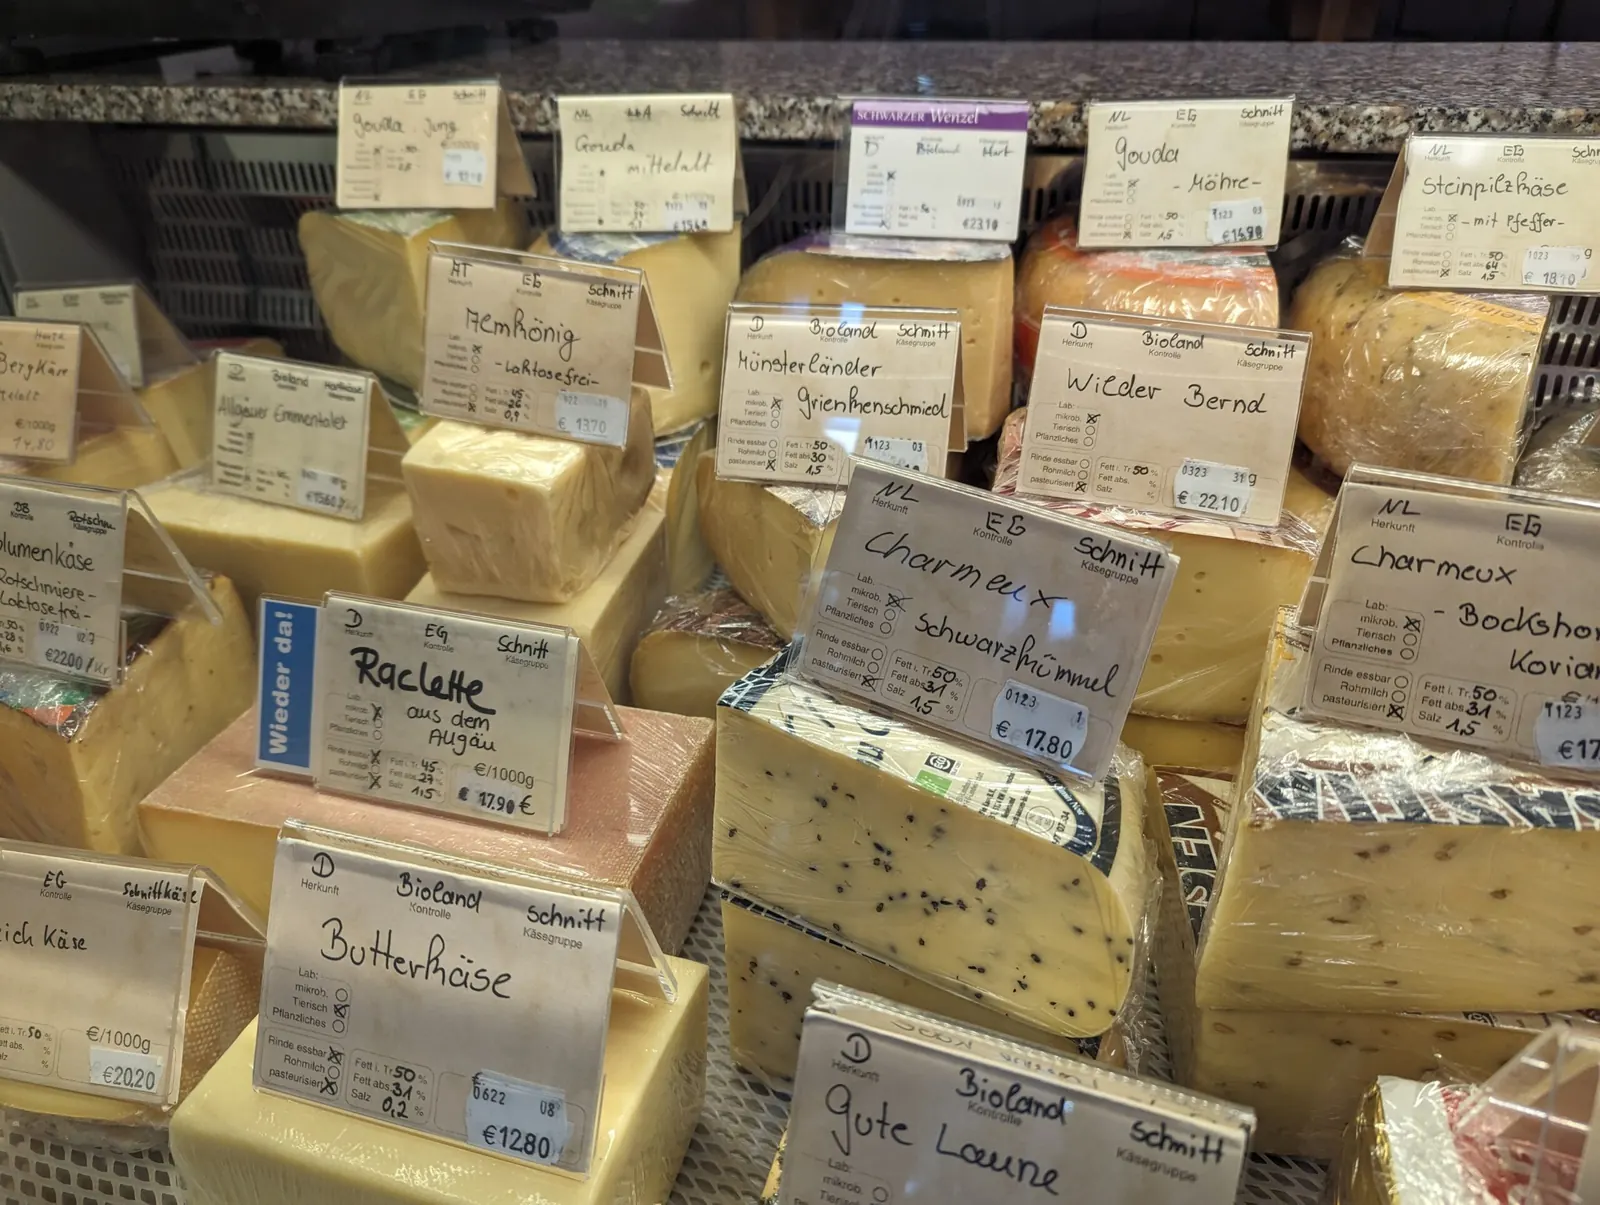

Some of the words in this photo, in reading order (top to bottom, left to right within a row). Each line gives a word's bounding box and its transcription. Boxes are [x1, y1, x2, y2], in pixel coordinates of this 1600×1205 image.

[858, 110, 925, 122] SCHWARZER
[931, 107, 979, 124] Wenzel
[1108, 111, 1131, 123] NL
[1176, 109, 1197, 122] EG
[1241, 105, 1284, 119] Schnitt
[575, 133, 635, 152] Gouda
[864, 142, 879, 156] D
[1429, 144, 1453, 155] NL
[1503, 145, 1524, 156] EG
[627, 150, 713, 174] mittelalt
[1422, 171, 1569, 201] Steinpilzkäse
[1474, 213, 1498, 229] mit
[522, 273, 541, 288] EG
[588, 284, 634, 300] Schnitt
[751, 316, 764, 333] D
[809, 318, 878, 339] Bioland
[897, 323, 950, 339] Schnitt
[1070, 321, 1088, 339] D
[895, 339, 936, 347] Käsegruppe
[1062, 339, 1093, 348] Herkunft
[1142, 330, 1204, 350] Bioland
[1149, 349, 1181, 359] Kontrolle
[1245, 343, 1296, 359] Schnitt
[739, 350, 882, 377] Münsterländer
[1237, 359, 1283, 371] Käsegruppe
[1067, 368, 1161, 399] Wilder
[1184, 384, 1266, 413] Bernd
[813, 441, 828, 450] 50
[810, 453, 826, 463] 30
[1132, 465, 1149, 475] 50
[1181, 465, 1207, 478] 0323
[875, 481, 919, 504] NL
[871, 496, 909, 515] Herkunft
[1199, 493, 1239, 513] 22.10
[1378, 498, 1421, 516] NL
[986, 512, 1026, 537] EG
[1371, 518, 1416, 533] Herkunft
[1506, 513, 1542, 537] EG
[973, 528, 1013, 547] Kontrolle
[1497, 536, 1544, 551] Kontrolle
[1074, 537, 1164, 579] Schnitt
[1351, 545, 1518, 585] Charmeux
[864, 531, 1068, 609] Charmeux
[1081, 559, 1139, 586] Käsegruppe
[851, 585, 882, 603] mikrob.
[824, 604, 874, 629] Pflanzliches
[846, 598, 879, 616] Tierisch
[345, 608, 363, 628] D
[1360, 614, 1398, 628] mikrob.
[274, 612, 293, 654] da!
[425, 623, 449, 644] EG
[816, 629, 839, 645] Rinde
[841, 637, 870, 655] essbar
[1356, 628, 1396, 642] Tierisch
[498, 634, 549, 657] Schnitt
[915, 613, 1120, 698] Schwarzkümmel
[1332, 638, 1392, 656] Pflanzliches
[827, 648, 866, 668] Rohmilch
[811, 658, 863, 682] pasteurisiert
[891, 670, 909, 684] Fett
[895, 656, 912, 670] Fett
[932, 667, 955, 684] 50
[1323, 664, 1352, 678] Rinde
[1356, 668, 1391, 684] essbar
[350, 647, 496, 715] Raclette
[886, 683, 906, 697] Salz
[1340, 681, 1388, 698] Rohmilch
[1005, 688, 1038, 709] 0123
[1424, 682, 1444, 694] Fett
[1472, 685, 1498, 701] 50
[269, 659, 290, 755] Wieder
[910, 696, 941, 715] 1,5
[1323, 694, 1386, 714] pasteurisiert
[1465, 702, 1492, 719] 31
[407, 705, 441, 724] aus
[452, 710, 490, 732] dem
[1418, 711, 1442, 723] Salz
[1446, 719, 1481, 736] 1,5
[1025, 727, 1073, 759] 17.80
[474, 763, 534, 789] €/1000g
[312, 851, 335, 879] D
[43, 870, 67, 889] EG
[301, 878, 339, 896] Herkunft
[40, 889, 72, 901] Kontrolle
[123, 880, 198, 904] Schnittkäse
[396, 871, 483, 913] Bioland
[126, 901, 172, 916] Käsegruppe
[409, 902, 452, 920] Kontrolle
[527, 903, 606, 932] Schnitt
[0, 921, 34, 947] ich
[43, 927, 87, 950] Käse
[523, 927, 583, 951] Käsegruppe
[320, 917, 512, 999] Butterkäse
[295, 982, 329, 999] mikrob.
[292, 996, 328, 1013] Tierisch
[272, 1007, 326, 1029] Pflanzliches
[28, 1026, 41, 1040] 50
[86, 1026, 151, 1054] €/1000g
[269, 1035, 293, 1052] Rinde
[296, 1042, 327, 1059] essbar
[840, 1032, 872, 1064] D
[284, 1054, 326, 1075] Rohmilch
[355, 1057, 374, 1072] Fett
[393, 1066, 416, 1083] 50
[103, 1066, 156, 1090] €20.20
[269, 1067, 324, 1090] pasteurisiert
[353, 1073, 371, 1087] Fett
[392, 1082, 413, 1100] 31
[351, 1089, 371, 1103] Salz
[473, 1086, 506, 1105] 0622
[956, 1067, 1068, 1125] Bioland
[382, 1098, 409, 1119] 0,2
[1130, 1120, 1226, 1165] Schnitt
[936, 1123, 1060, 1197] Laune
[1116, 1147, 1197, 1183] Käsegruppe
